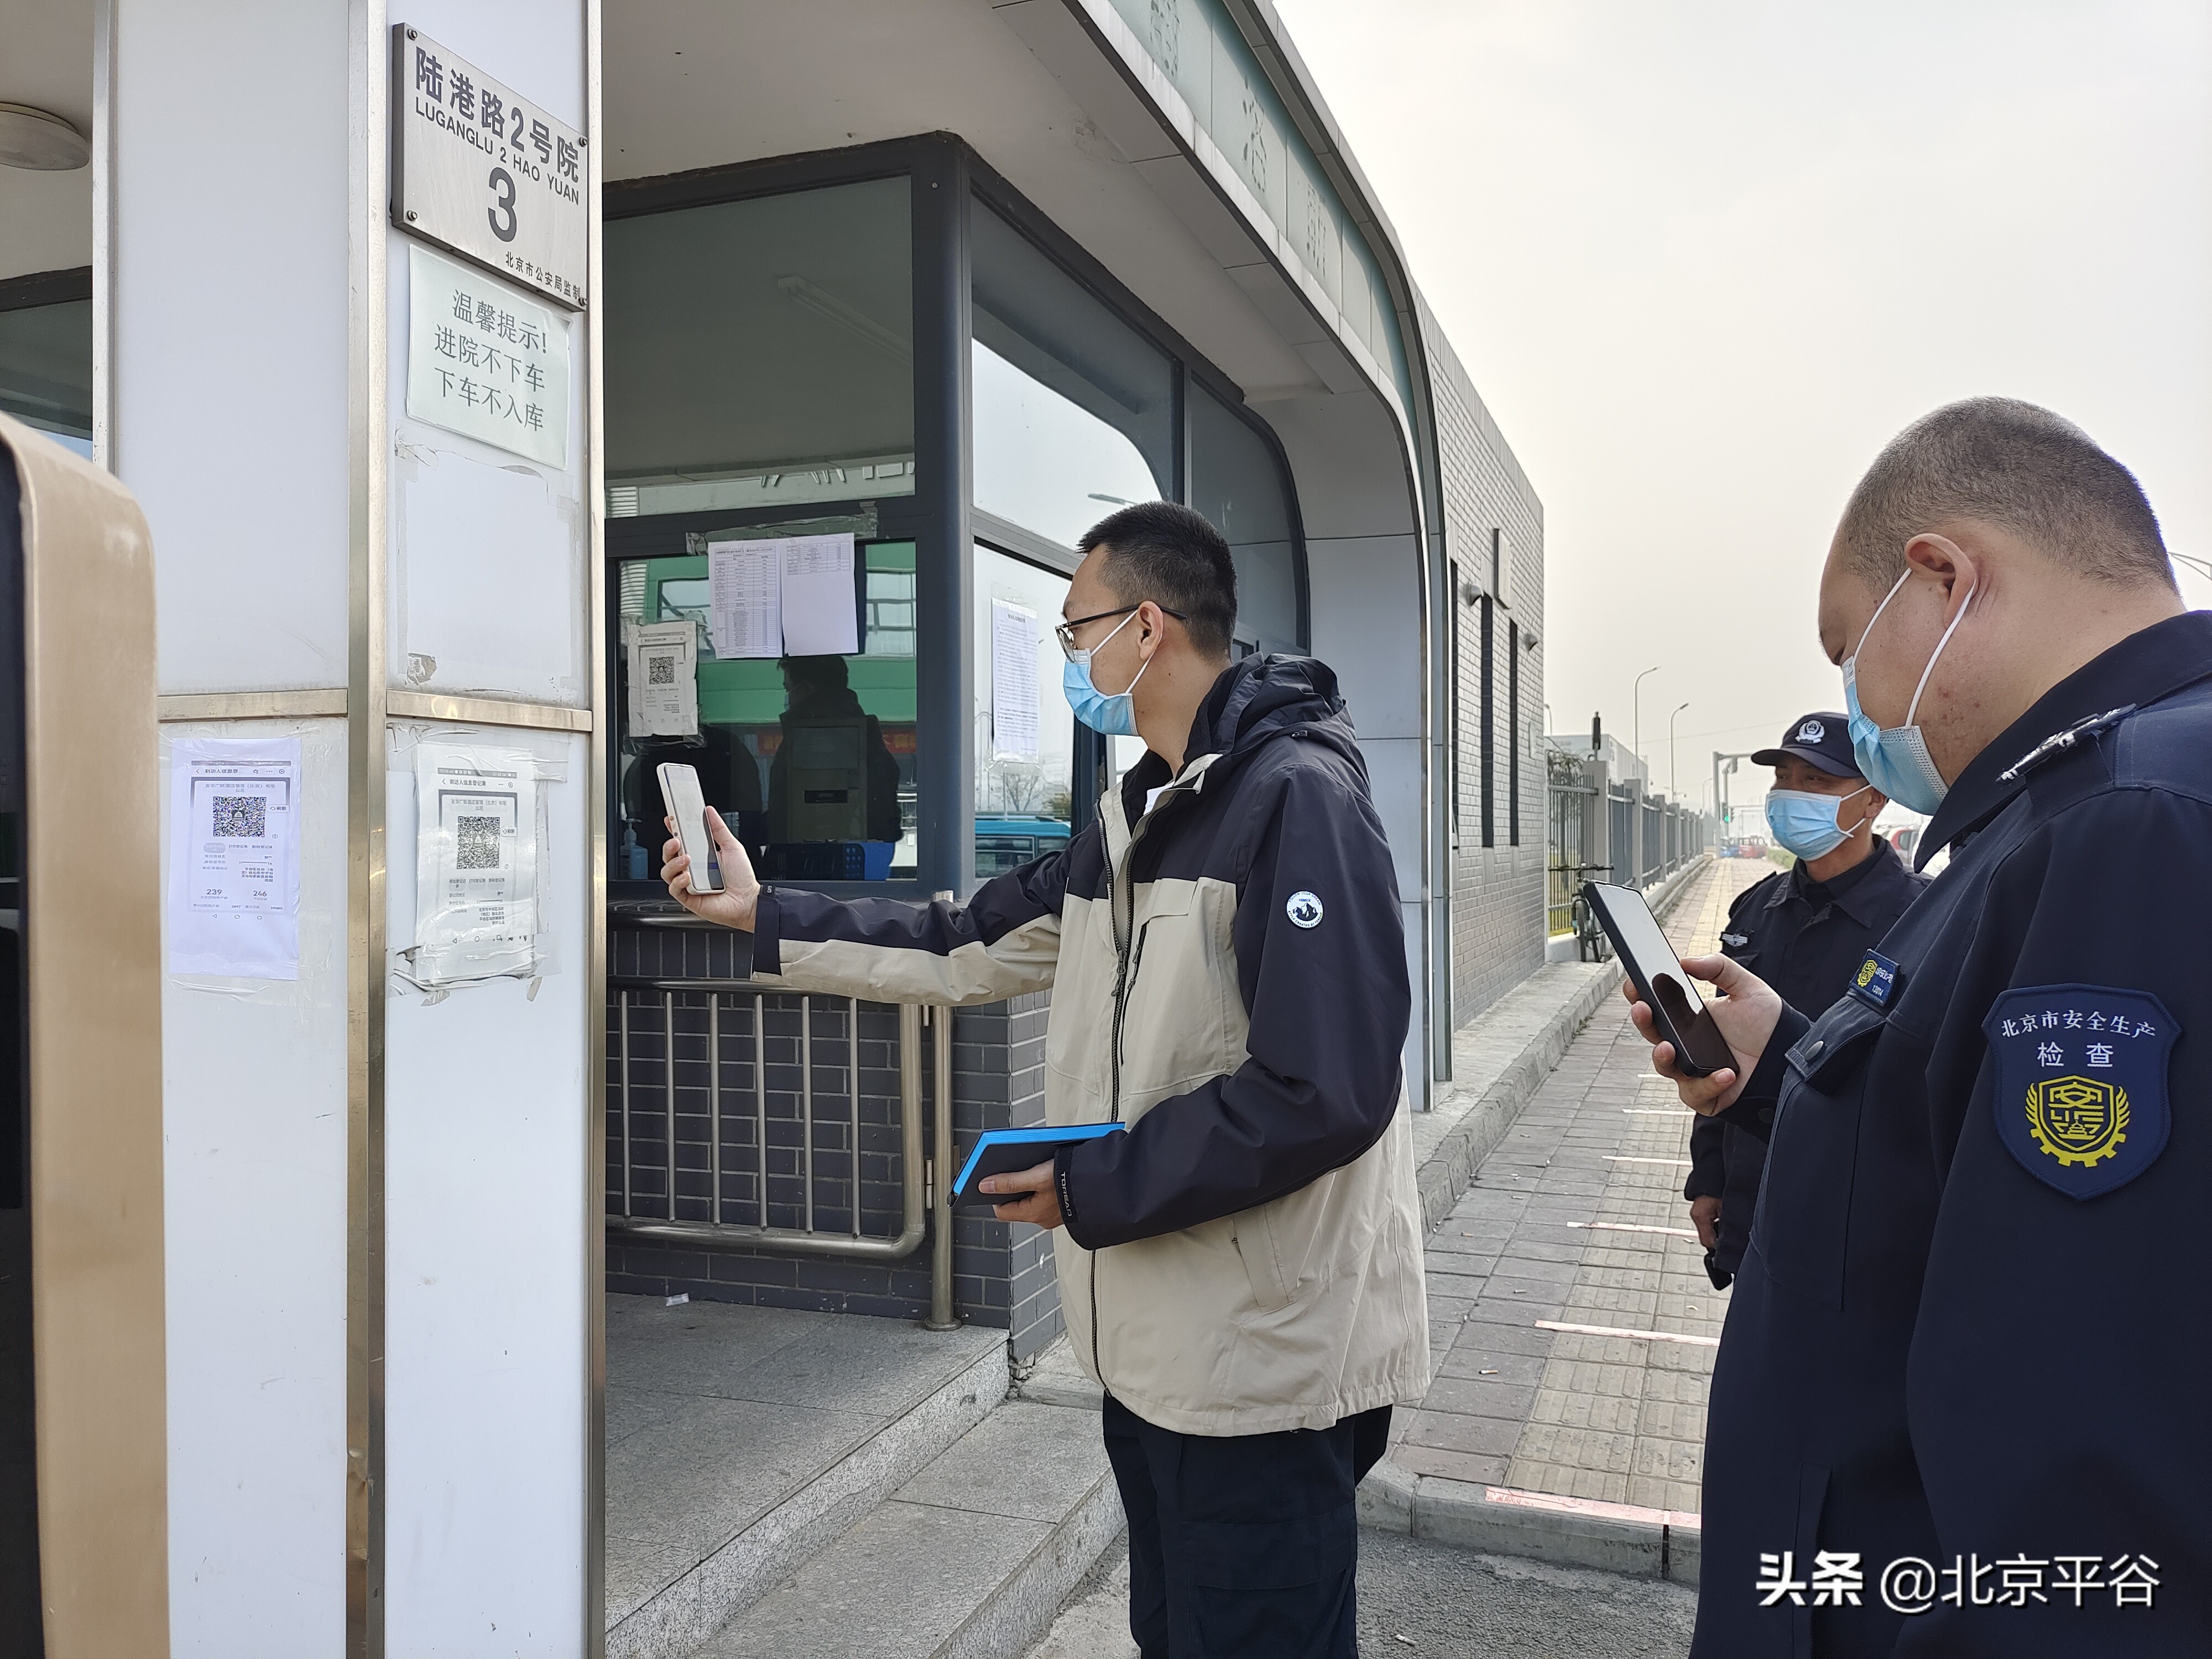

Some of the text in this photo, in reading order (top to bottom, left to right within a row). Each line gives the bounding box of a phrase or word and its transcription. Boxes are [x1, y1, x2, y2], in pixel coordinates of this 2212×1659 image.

[416, 46, 578, 183] 陆港路2号院
[416, 97, 579, 206] LUGANGLU 2 HAO YUAN
[488, 167, 517, 242] 3
[505, 251, 581, 300] 北京市公安局监制
[434, 324, 545, 392] 进院不下车
[434, 367, 544, 432] 下车不入库
[2001, 1009, 2156, 1038] 北京市安全生产
[2037, 1041, 2114, 1067] 检查
[1061, 1171, 1072, 1217] TOREAD
